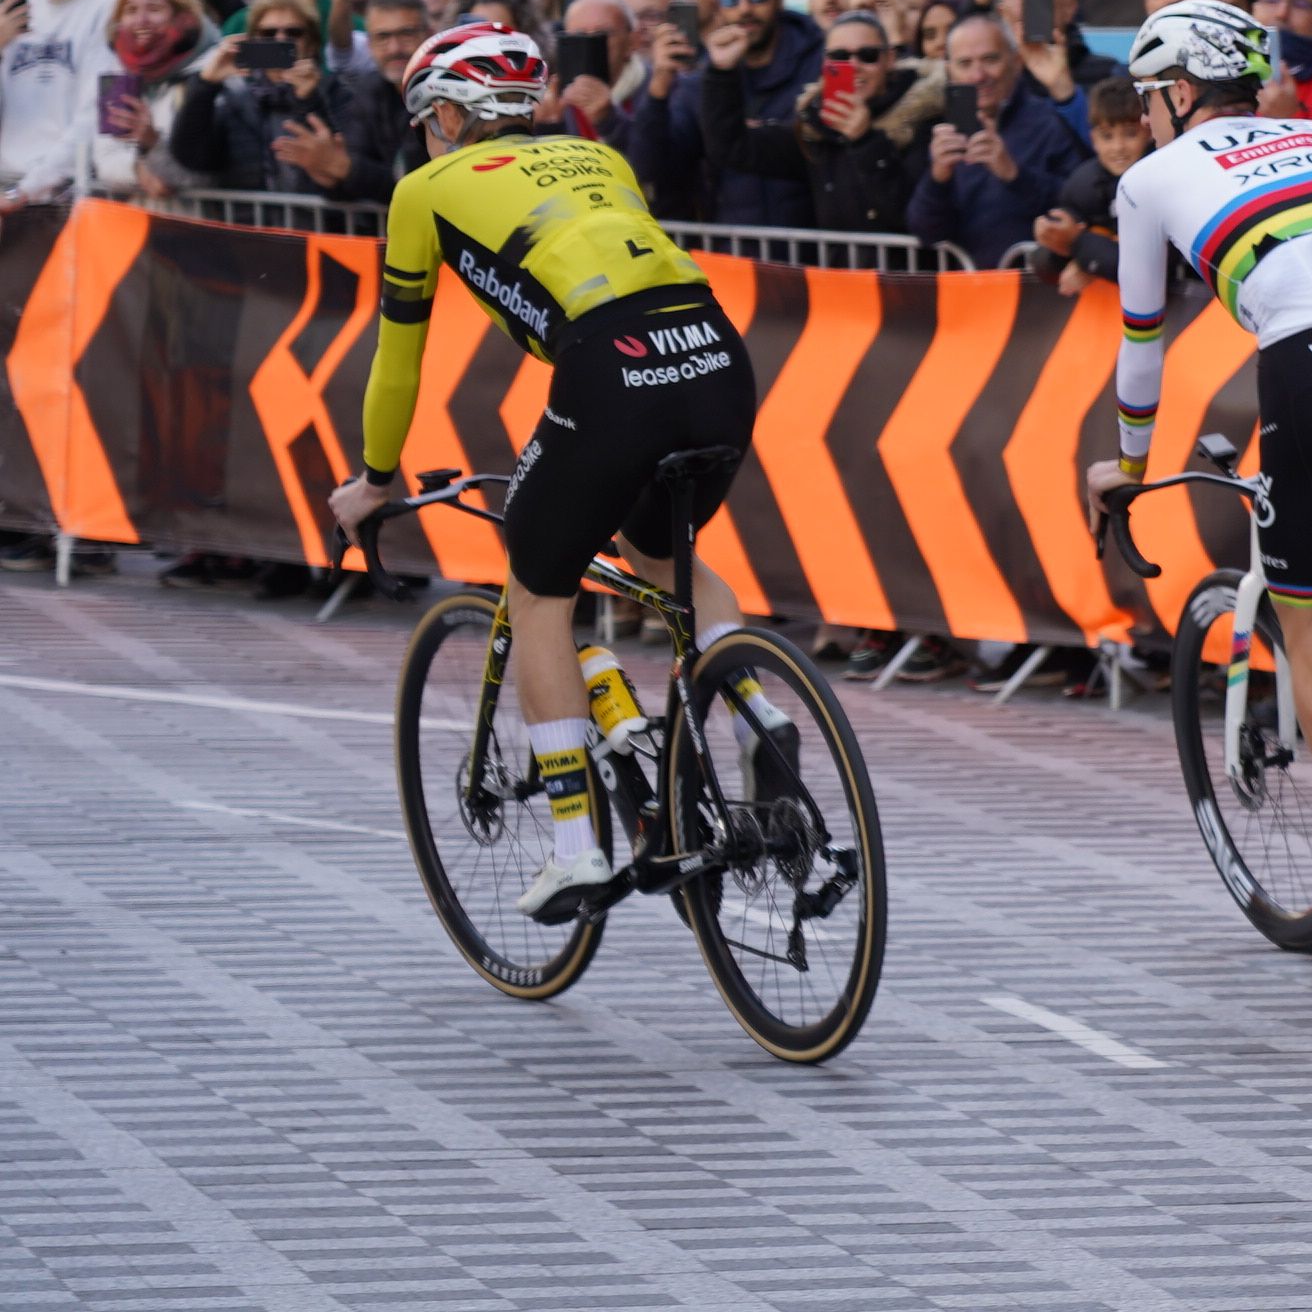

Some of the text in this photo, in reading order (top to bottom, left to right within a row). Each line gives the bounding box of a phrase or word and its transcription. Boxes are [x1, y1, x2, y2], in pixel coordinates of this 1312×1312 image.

[520, 143, 614, 161] VISMA
[520, 156, 601, 177] lease
[459, 249, 549, 342] Rabobank
[648, 321, 721, 356] VISMA
[622, 367, 681, 388] lease
[544, 755, 579, 772] VISMA
